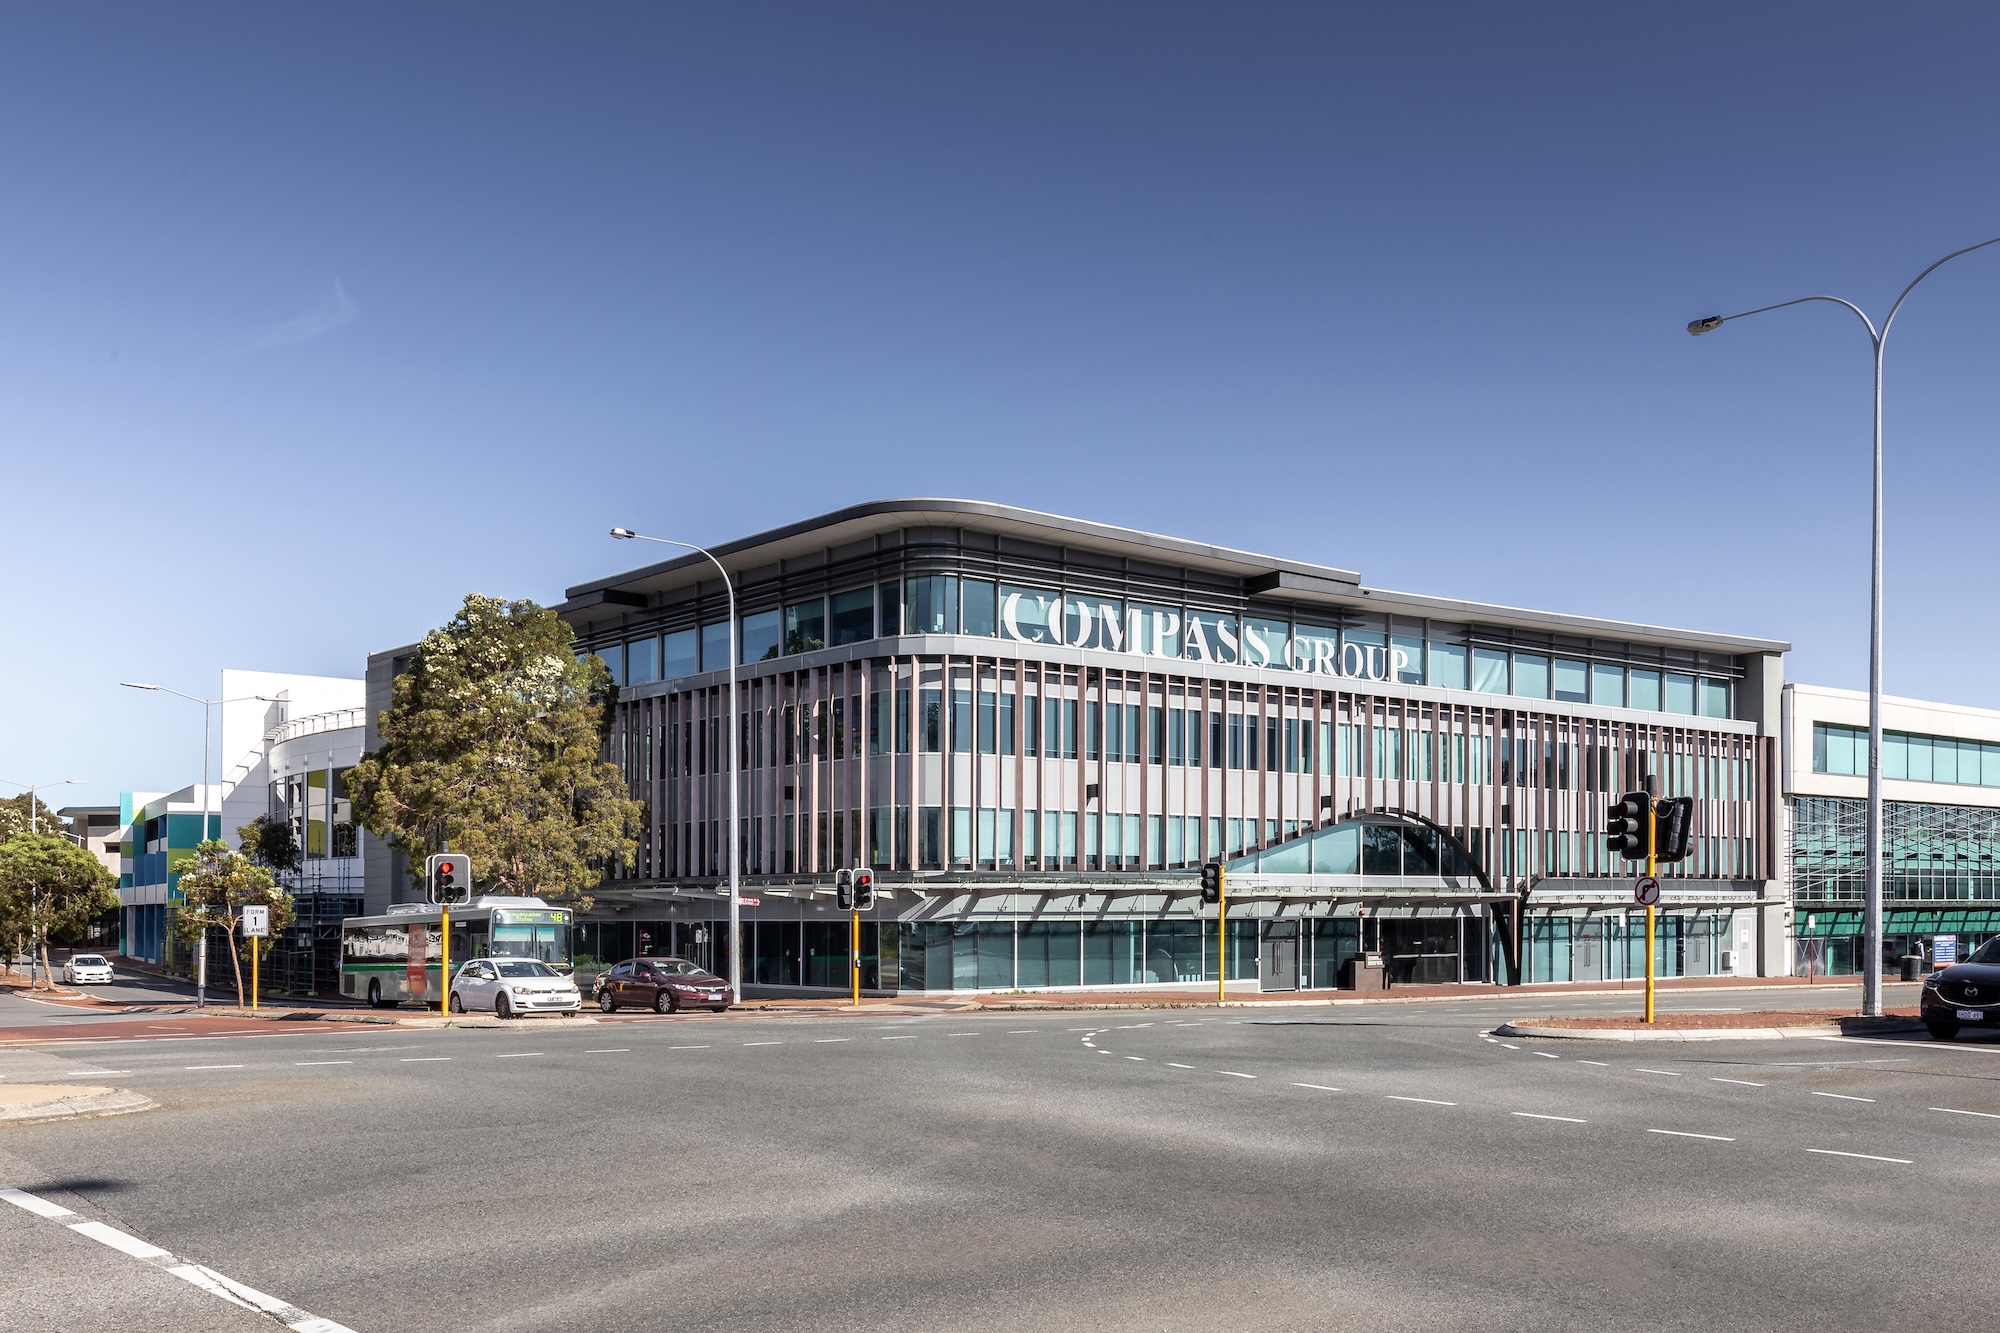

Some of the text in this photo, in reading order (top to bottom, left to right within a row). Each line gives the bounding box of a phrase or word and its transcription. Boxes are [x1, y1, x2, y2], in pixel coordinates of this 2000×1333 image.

[1003, 592, 1408, 683] COMPASS GROUP
[253, 916, 257, 926] 1
[550, 912, 563, 922] 48
